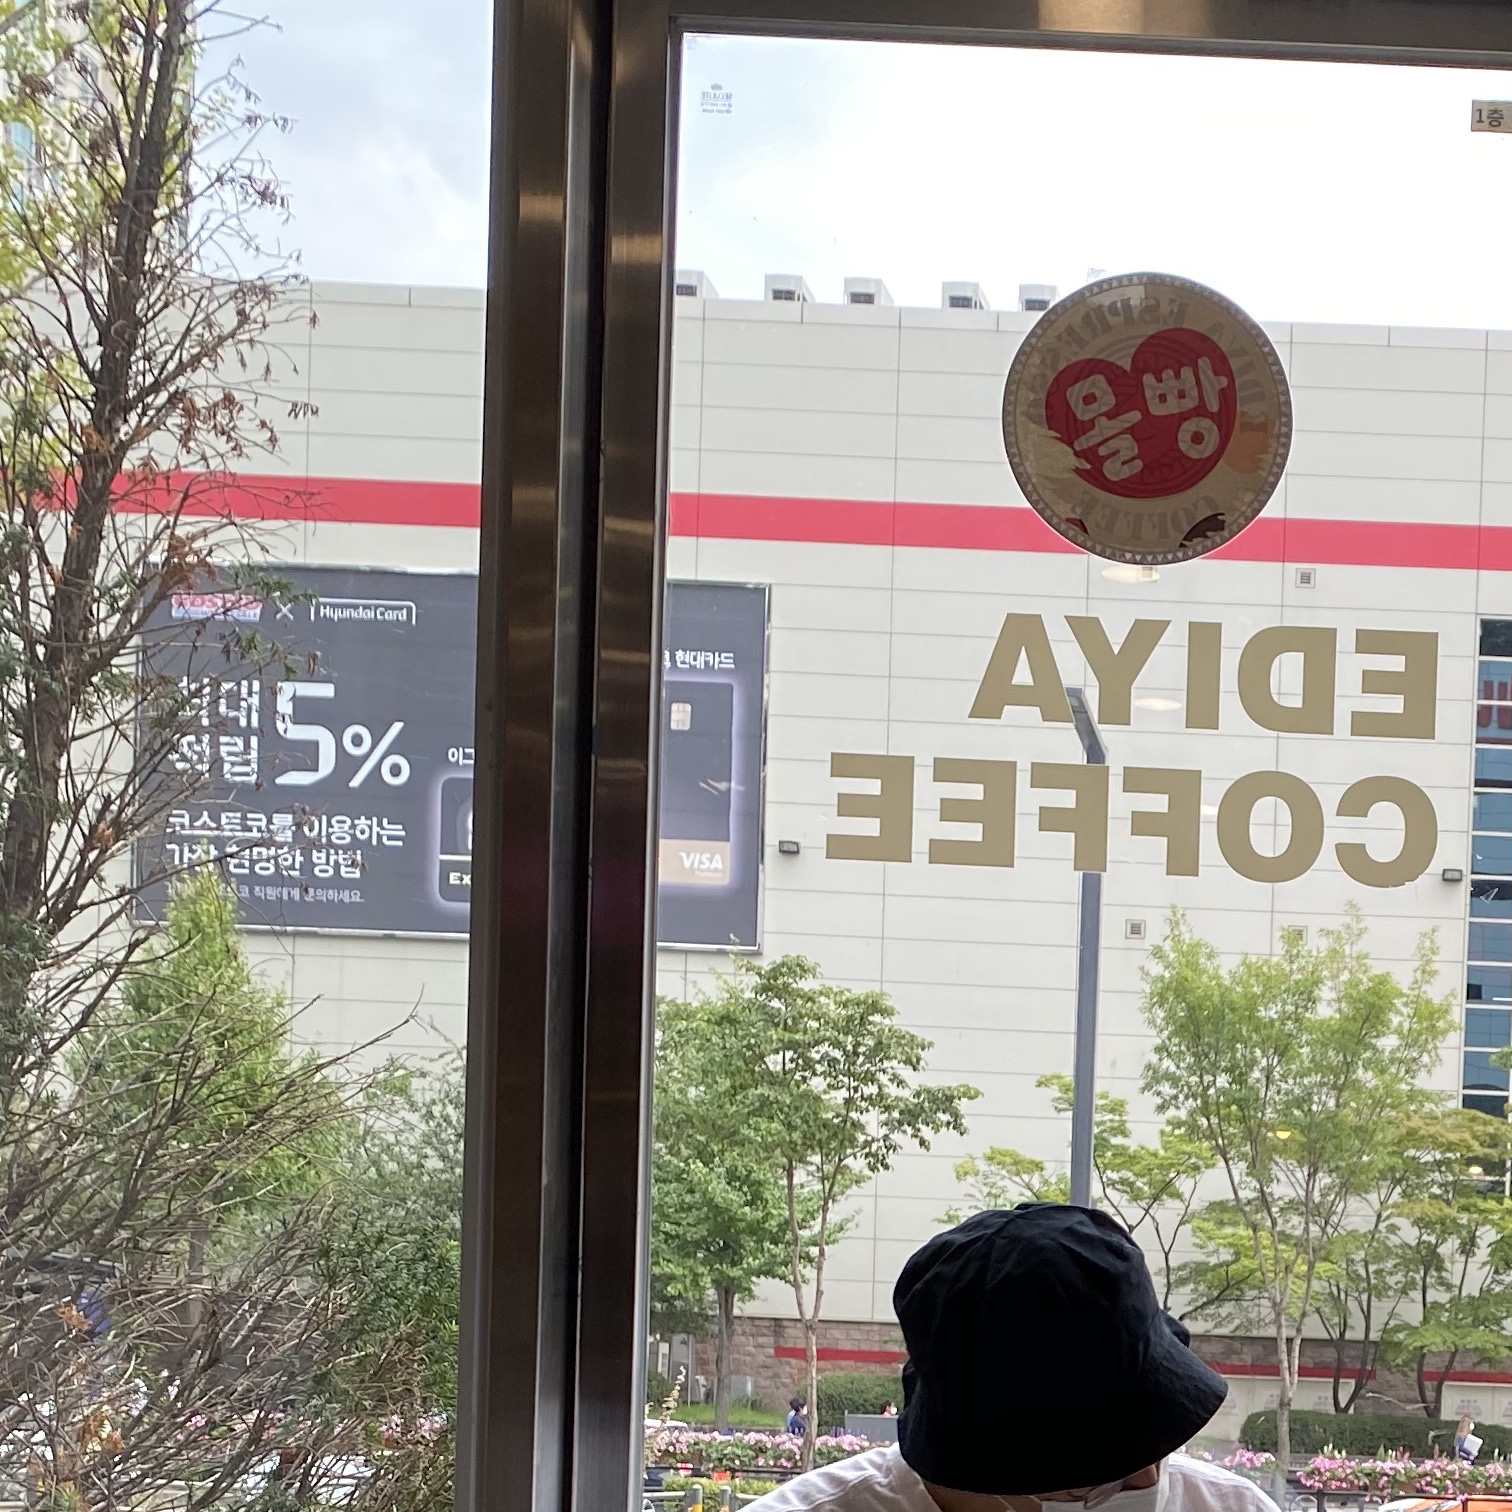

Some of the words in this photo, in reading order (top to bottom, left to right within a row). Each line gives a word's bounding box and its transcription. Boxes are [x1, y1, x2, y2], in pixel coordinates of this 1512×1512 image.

[1475, 107, 1505, 128] 1층
[319, 604, 375, 623] Hyundai
[375, 607, 407, 622] Card
[675, 648, 736, 670] 현대카드
[275, 680, 411, 788] 5%
[166, 808, 295, 844] 코스트코를
[302, 810, 407, 847] 이용하는
[679, 851, 724, 870] VISA
